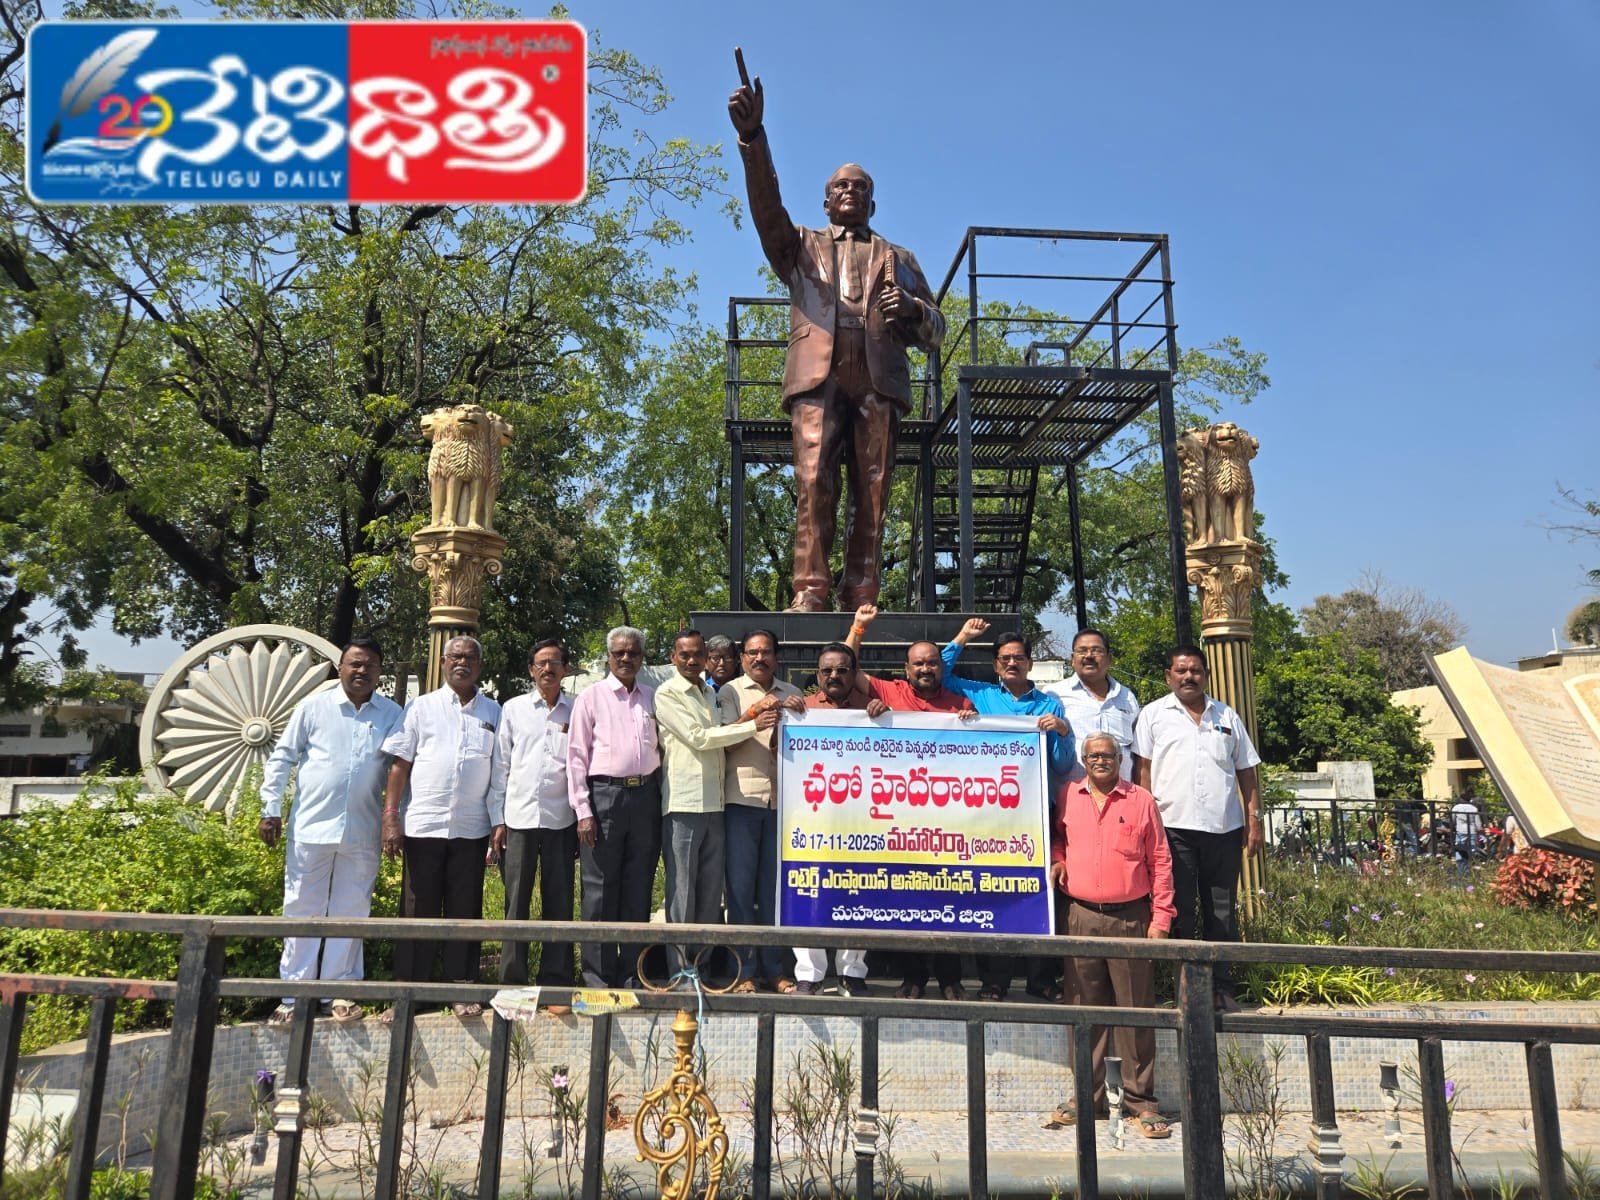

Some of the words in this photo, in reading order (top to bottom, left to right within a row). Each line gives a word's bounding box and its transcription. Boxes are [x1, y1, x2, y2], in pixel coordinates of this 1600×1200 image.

[788, 737, 819, 752] 2024
[820, 737, 844, 758] మార్చి
[845, 736, 872, 752] నుండి
[980, 742, 1008, 758] సాధన
[1009, 741, 1035, 757] కోసం
[802, 762, 863, 813] ఛలో
[869, 765, 1021, 820] హైదరాబాద్
[809, 833, 886, 851] 17-11-2025న
[887, 826, 972, 861] మహాధర్నా
[979, 872, 1040, 894] తెలంగాణ
[831, 904, 956, 924] మహబూబాబాద్
[958, 909, 994, 929] జిల్లా
